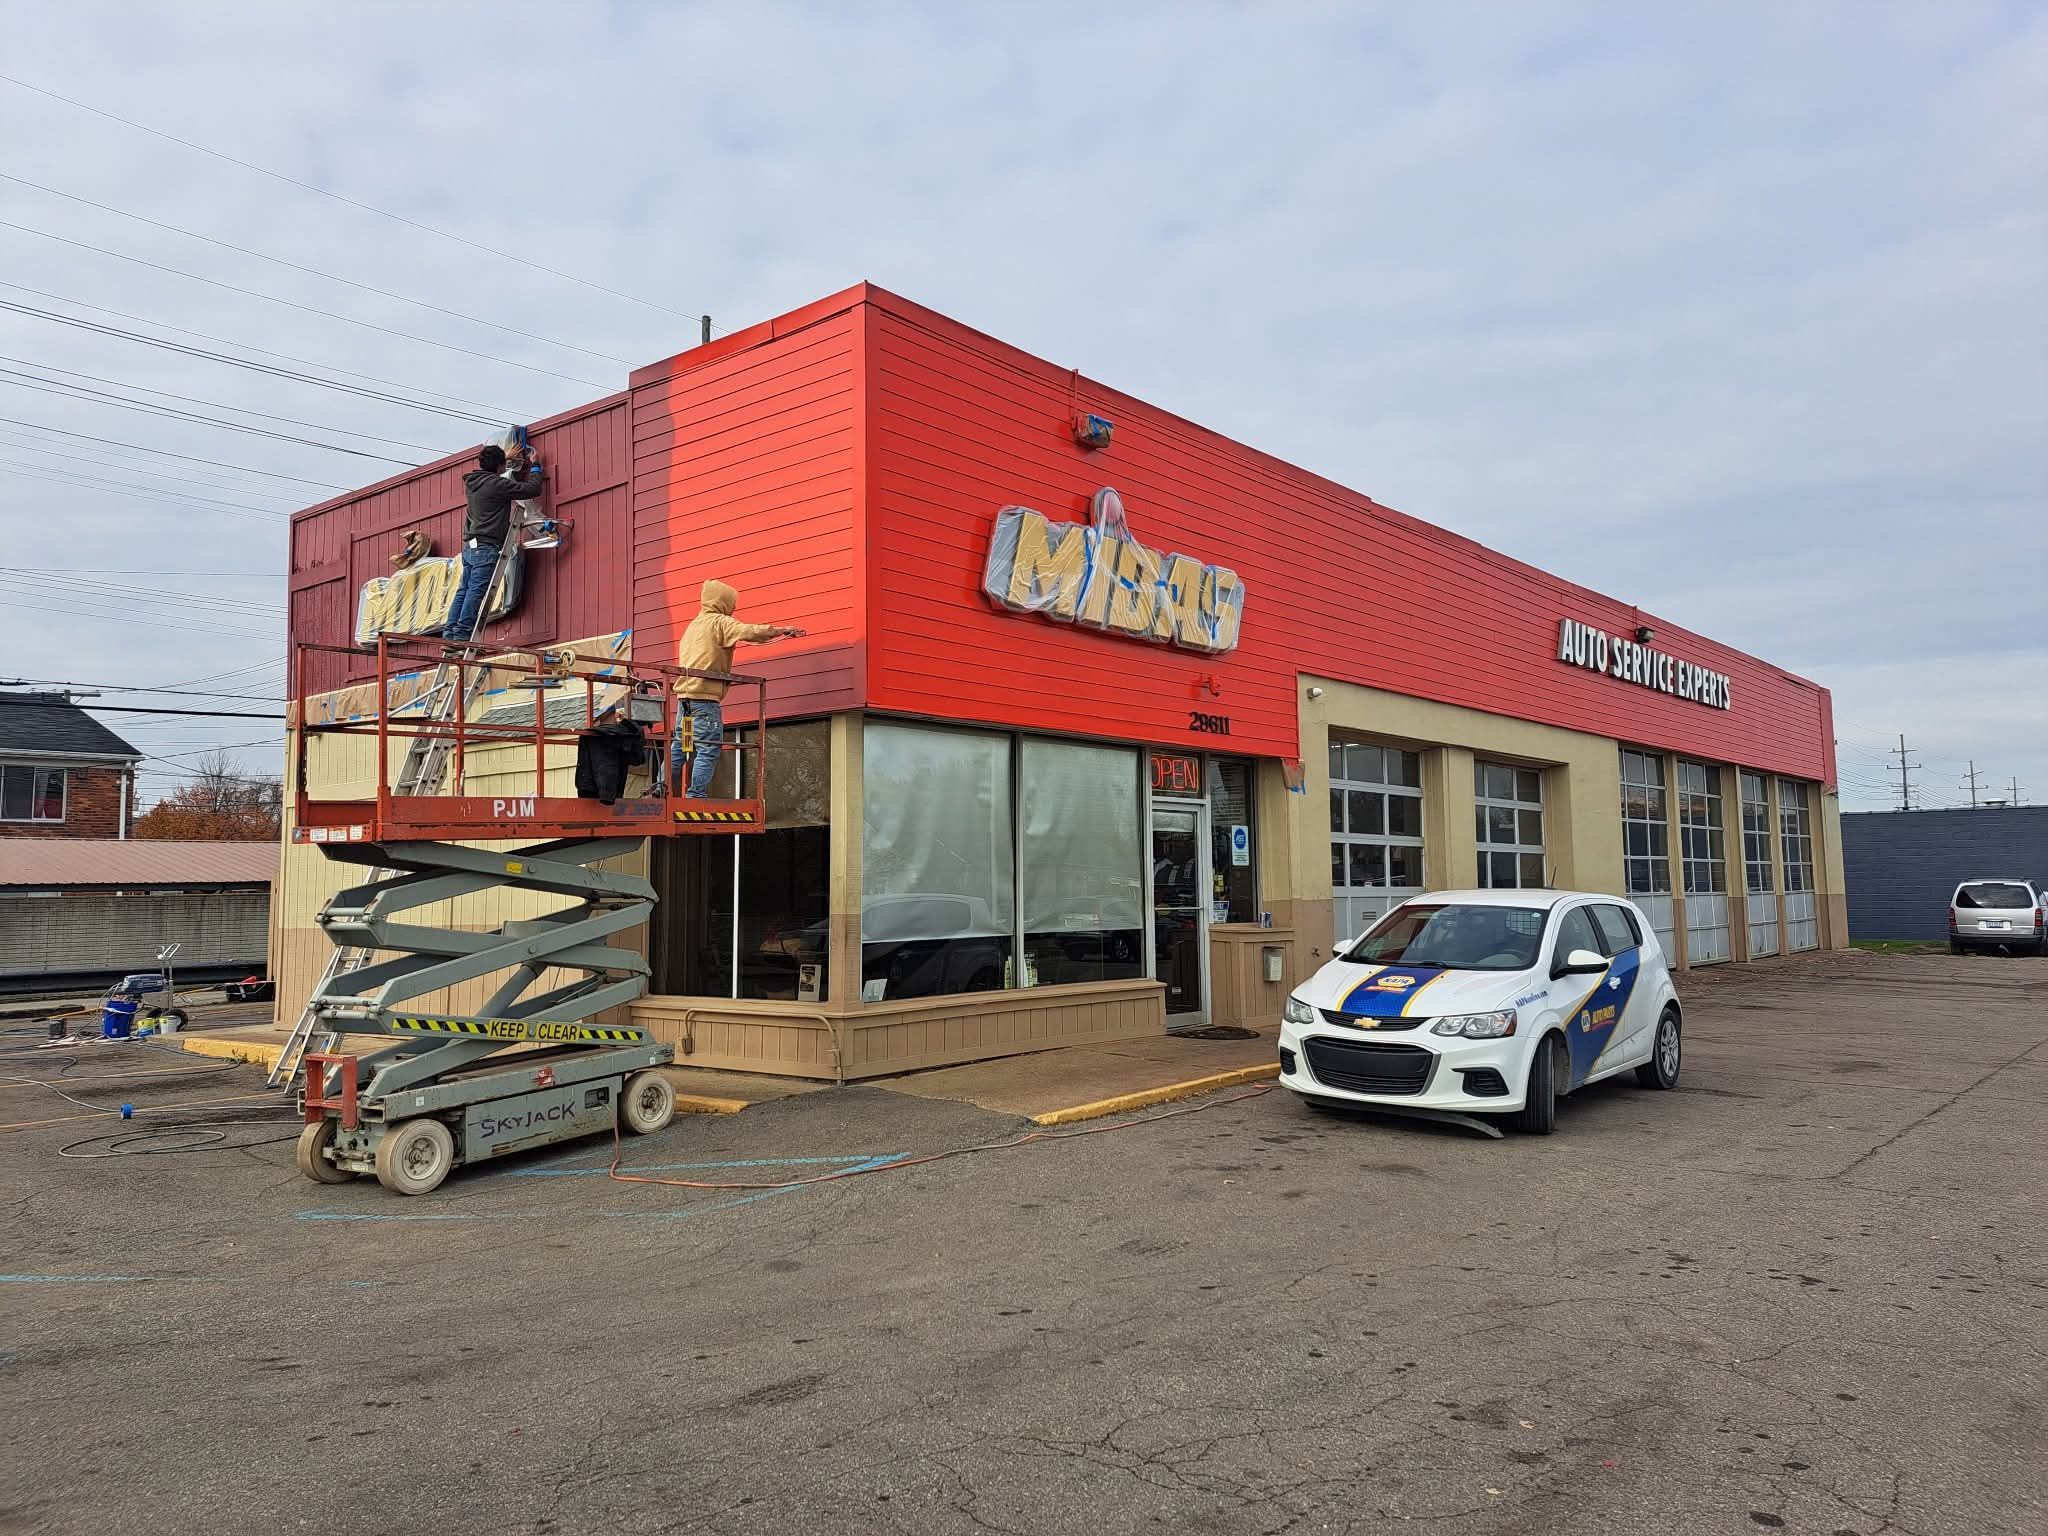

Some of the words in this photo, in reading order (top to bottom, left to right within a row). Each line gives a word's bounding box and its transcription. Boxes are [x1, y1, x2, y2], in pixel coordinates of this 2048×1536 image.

[1561, 618, 1608, 673] AUTO
[1612, 637, 1674, 694] SERVICE
[1678, 659, 1731, 711] EXPERTS
[1151, 757, 1197, 789] OPEN
[493, 799, 535, 817] PJM
[490, 1021, 525, 1038] KEEP
[538, 1023, 578, 1040] CLEAR
[480, 1100, 576, 1139] SKYJACK
